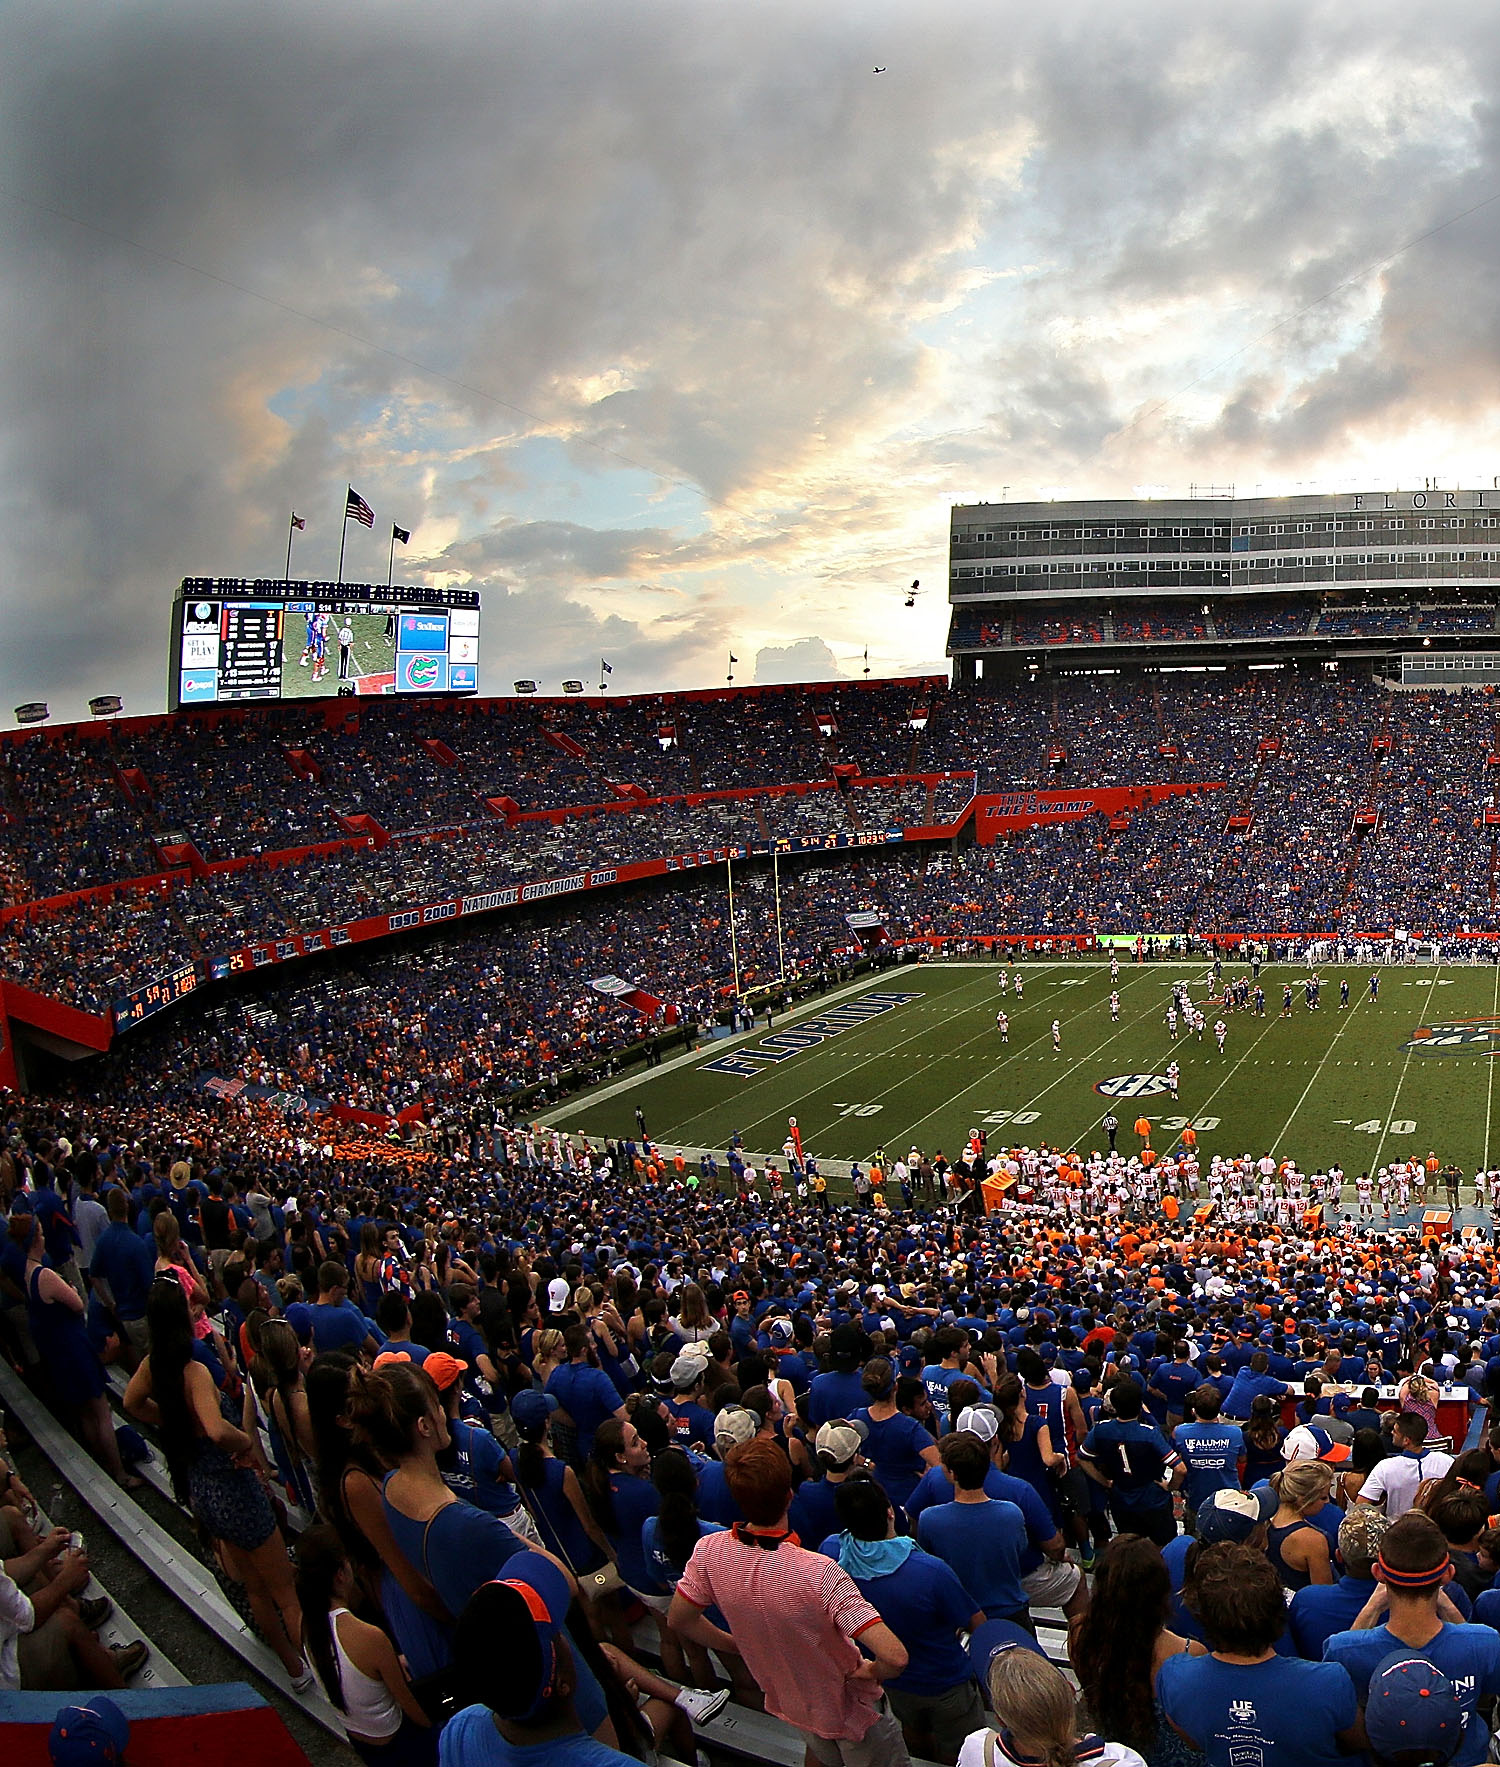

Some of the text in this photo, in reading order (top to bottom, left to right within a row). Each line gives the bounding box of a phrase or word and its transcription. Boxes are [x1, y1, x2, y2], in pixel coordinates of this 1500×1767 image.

[1000, 793, 1037, 805] THIS IS
[985, 800, 1095, 818] THE SWAMP
[389, 869, 617, 930] 1996 2006 NATIONAL CHAMPIONS 2008
[230, 954, 244, 970] 25
[695, 992, 926, 1079] FLORIDA
[1099, 1074, 1171, 1097] SEC
[841, 1104, 884, 1117] 10
[982, 1110, 1042, 1125] 20
[1160, 1116, 1222, 1131] 30
[1353, 1119, 1417, 1135] 40
[1118, 1444, 1132, 1474] 1
[1190, 1458, 1226, 1466] GEICO
